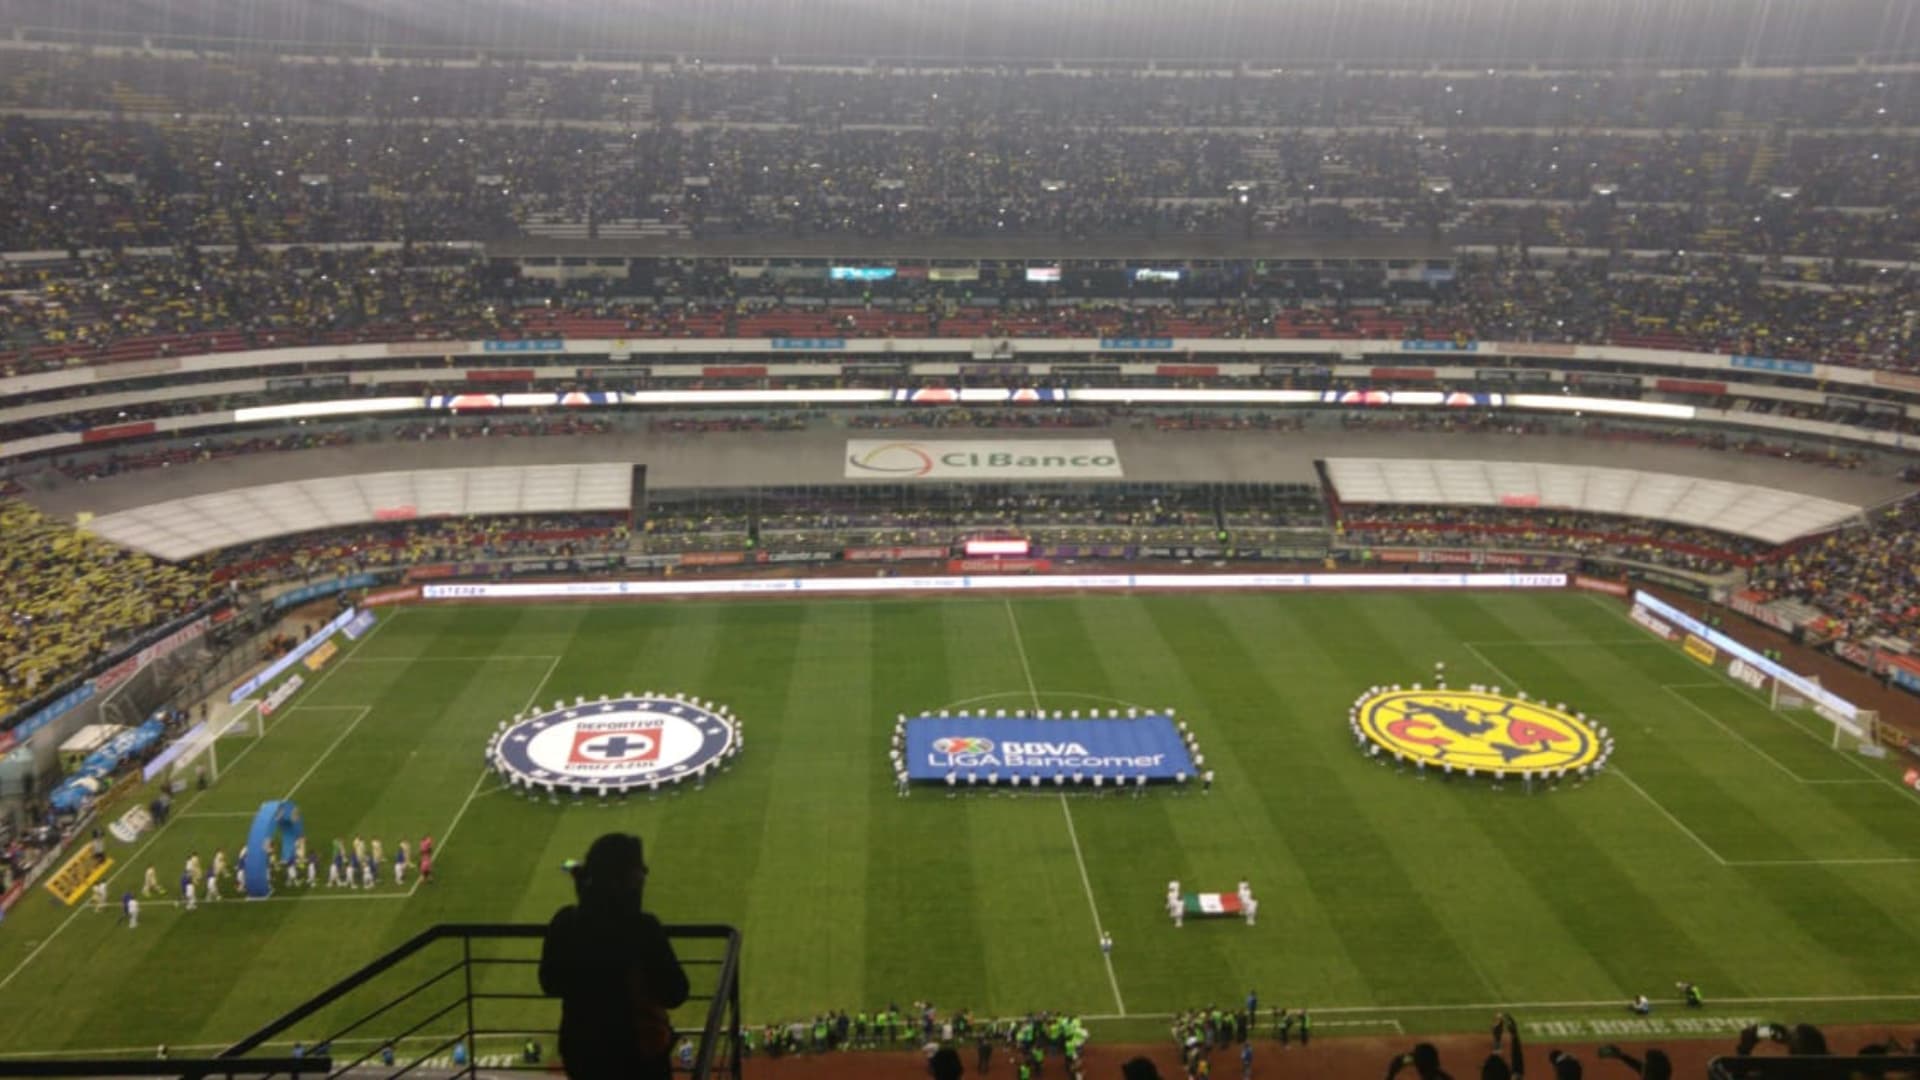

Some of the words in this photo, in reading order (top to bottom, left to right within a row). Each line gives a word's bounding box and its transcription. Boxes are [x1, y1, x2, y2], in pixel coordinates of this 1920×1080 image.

[941, 452, 1115, 467] CIBanco
[577, 719, 665, 730] DEPORTIVO
[1002, 742, 1089, 755] BBVA
[565, 762, 610, 771] CRUZ
[614, 760, 655, 769] AZUL
[927, 754, 998, 767] LIGA
[1003, 754, 1165, 767] Bancomer
